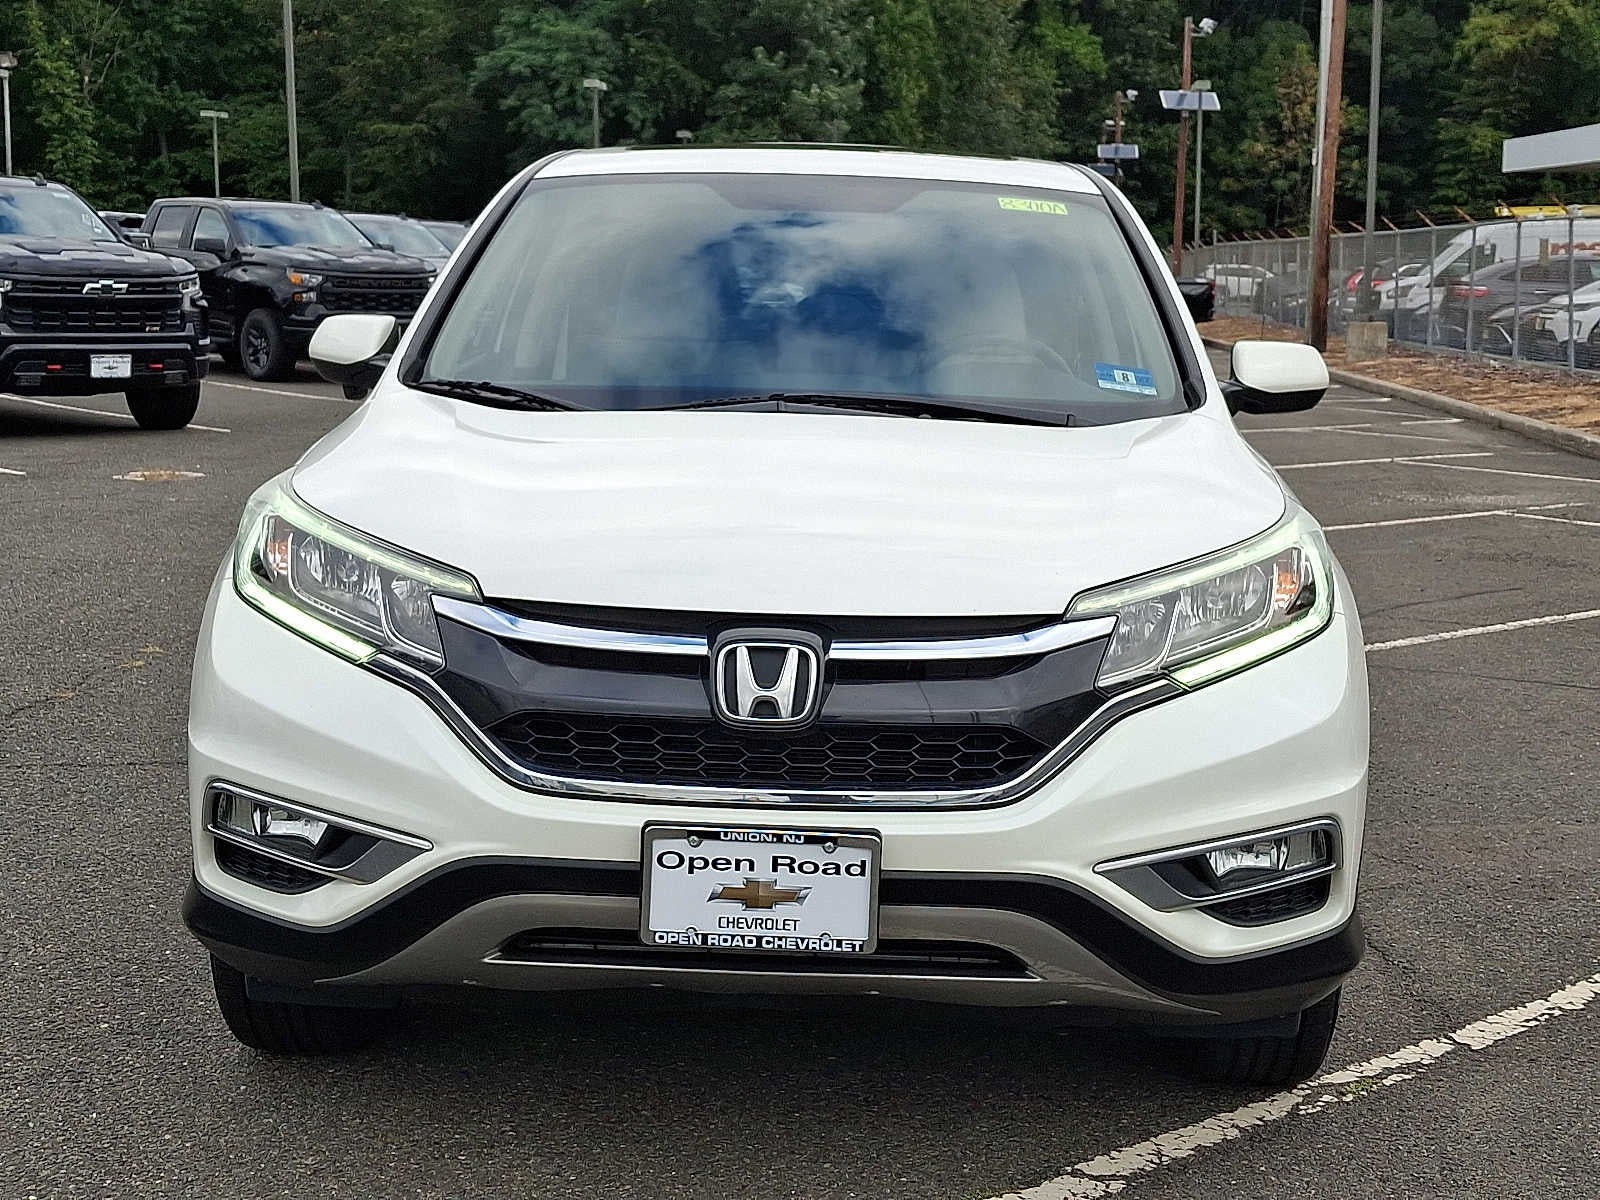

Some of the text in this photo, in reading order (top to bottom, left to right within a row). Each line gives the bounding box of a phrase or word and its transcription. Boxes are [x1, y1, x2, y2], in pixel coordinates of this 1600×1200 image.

[782, 833, 805, 844] NJ
[656, 850, 867, 877] Open Road
[718, 916, 800, 932] CHEVROLET
[654, 931, 864, 952] OPEN ROAD CHEVROLET
